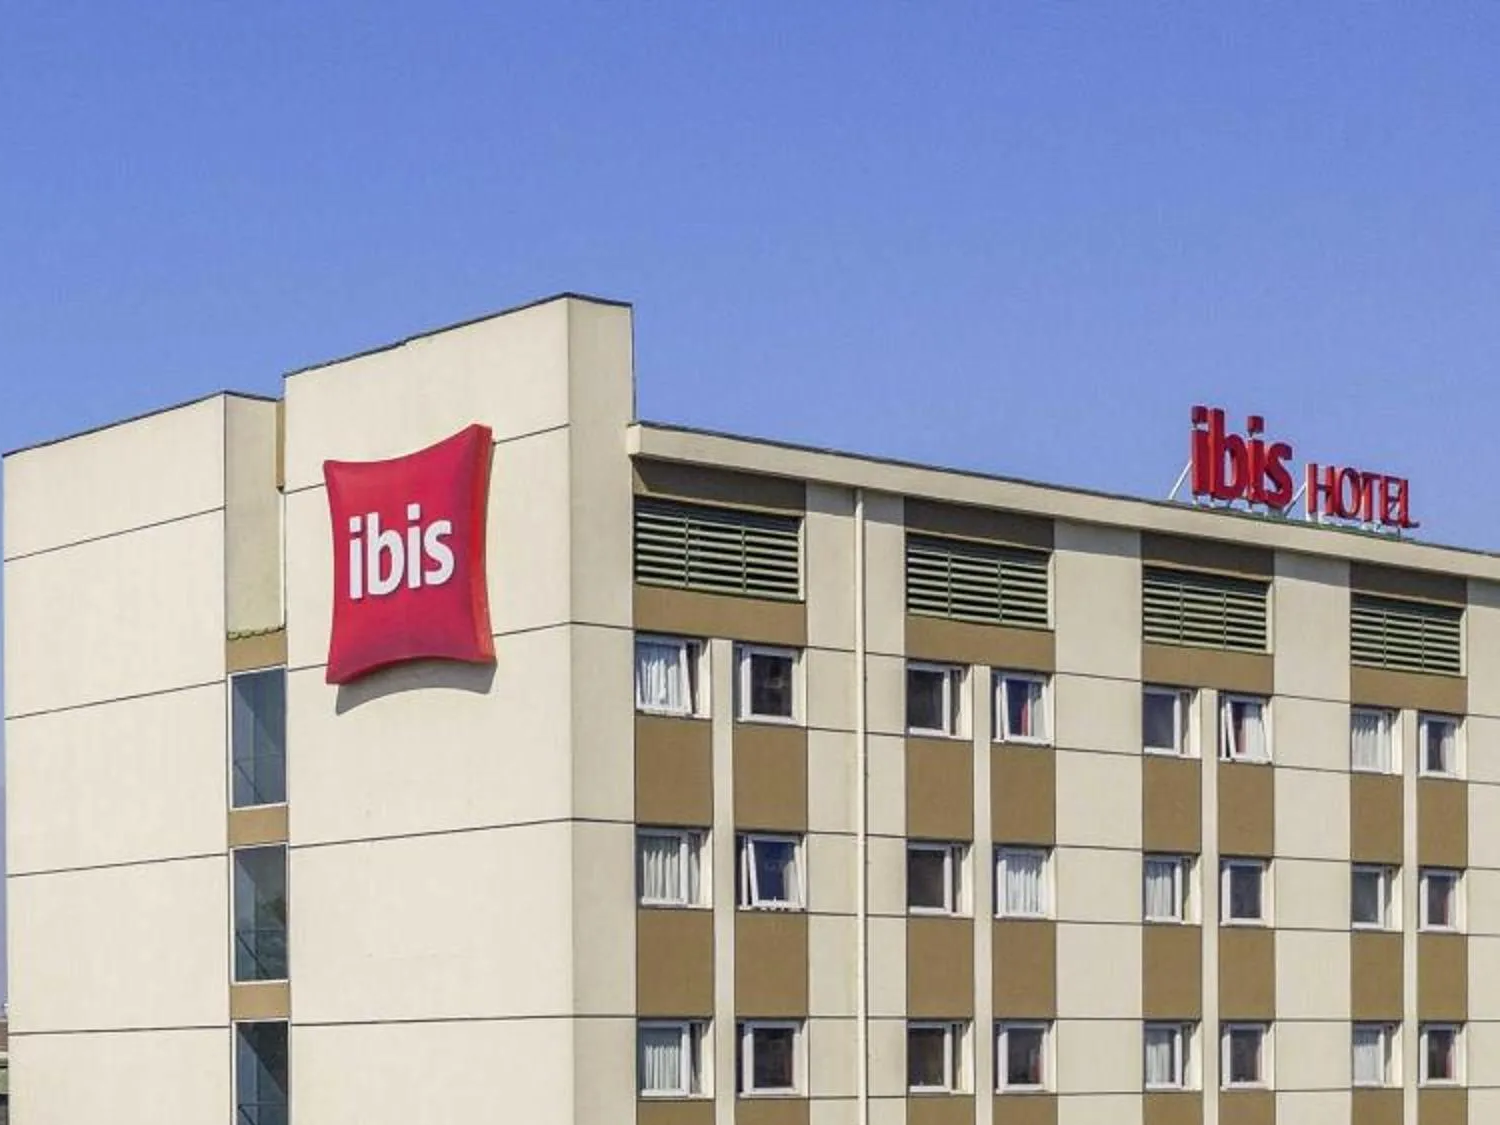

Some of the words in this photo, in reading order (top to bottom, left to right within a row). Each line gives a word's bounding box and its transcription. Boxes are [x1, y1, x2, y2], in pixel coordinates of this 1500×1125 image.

[1191, 405, 1293, 509] ibis
[1305, 463, 1420, 529] HOTEL
[349, 503, 455, 600] ibis
